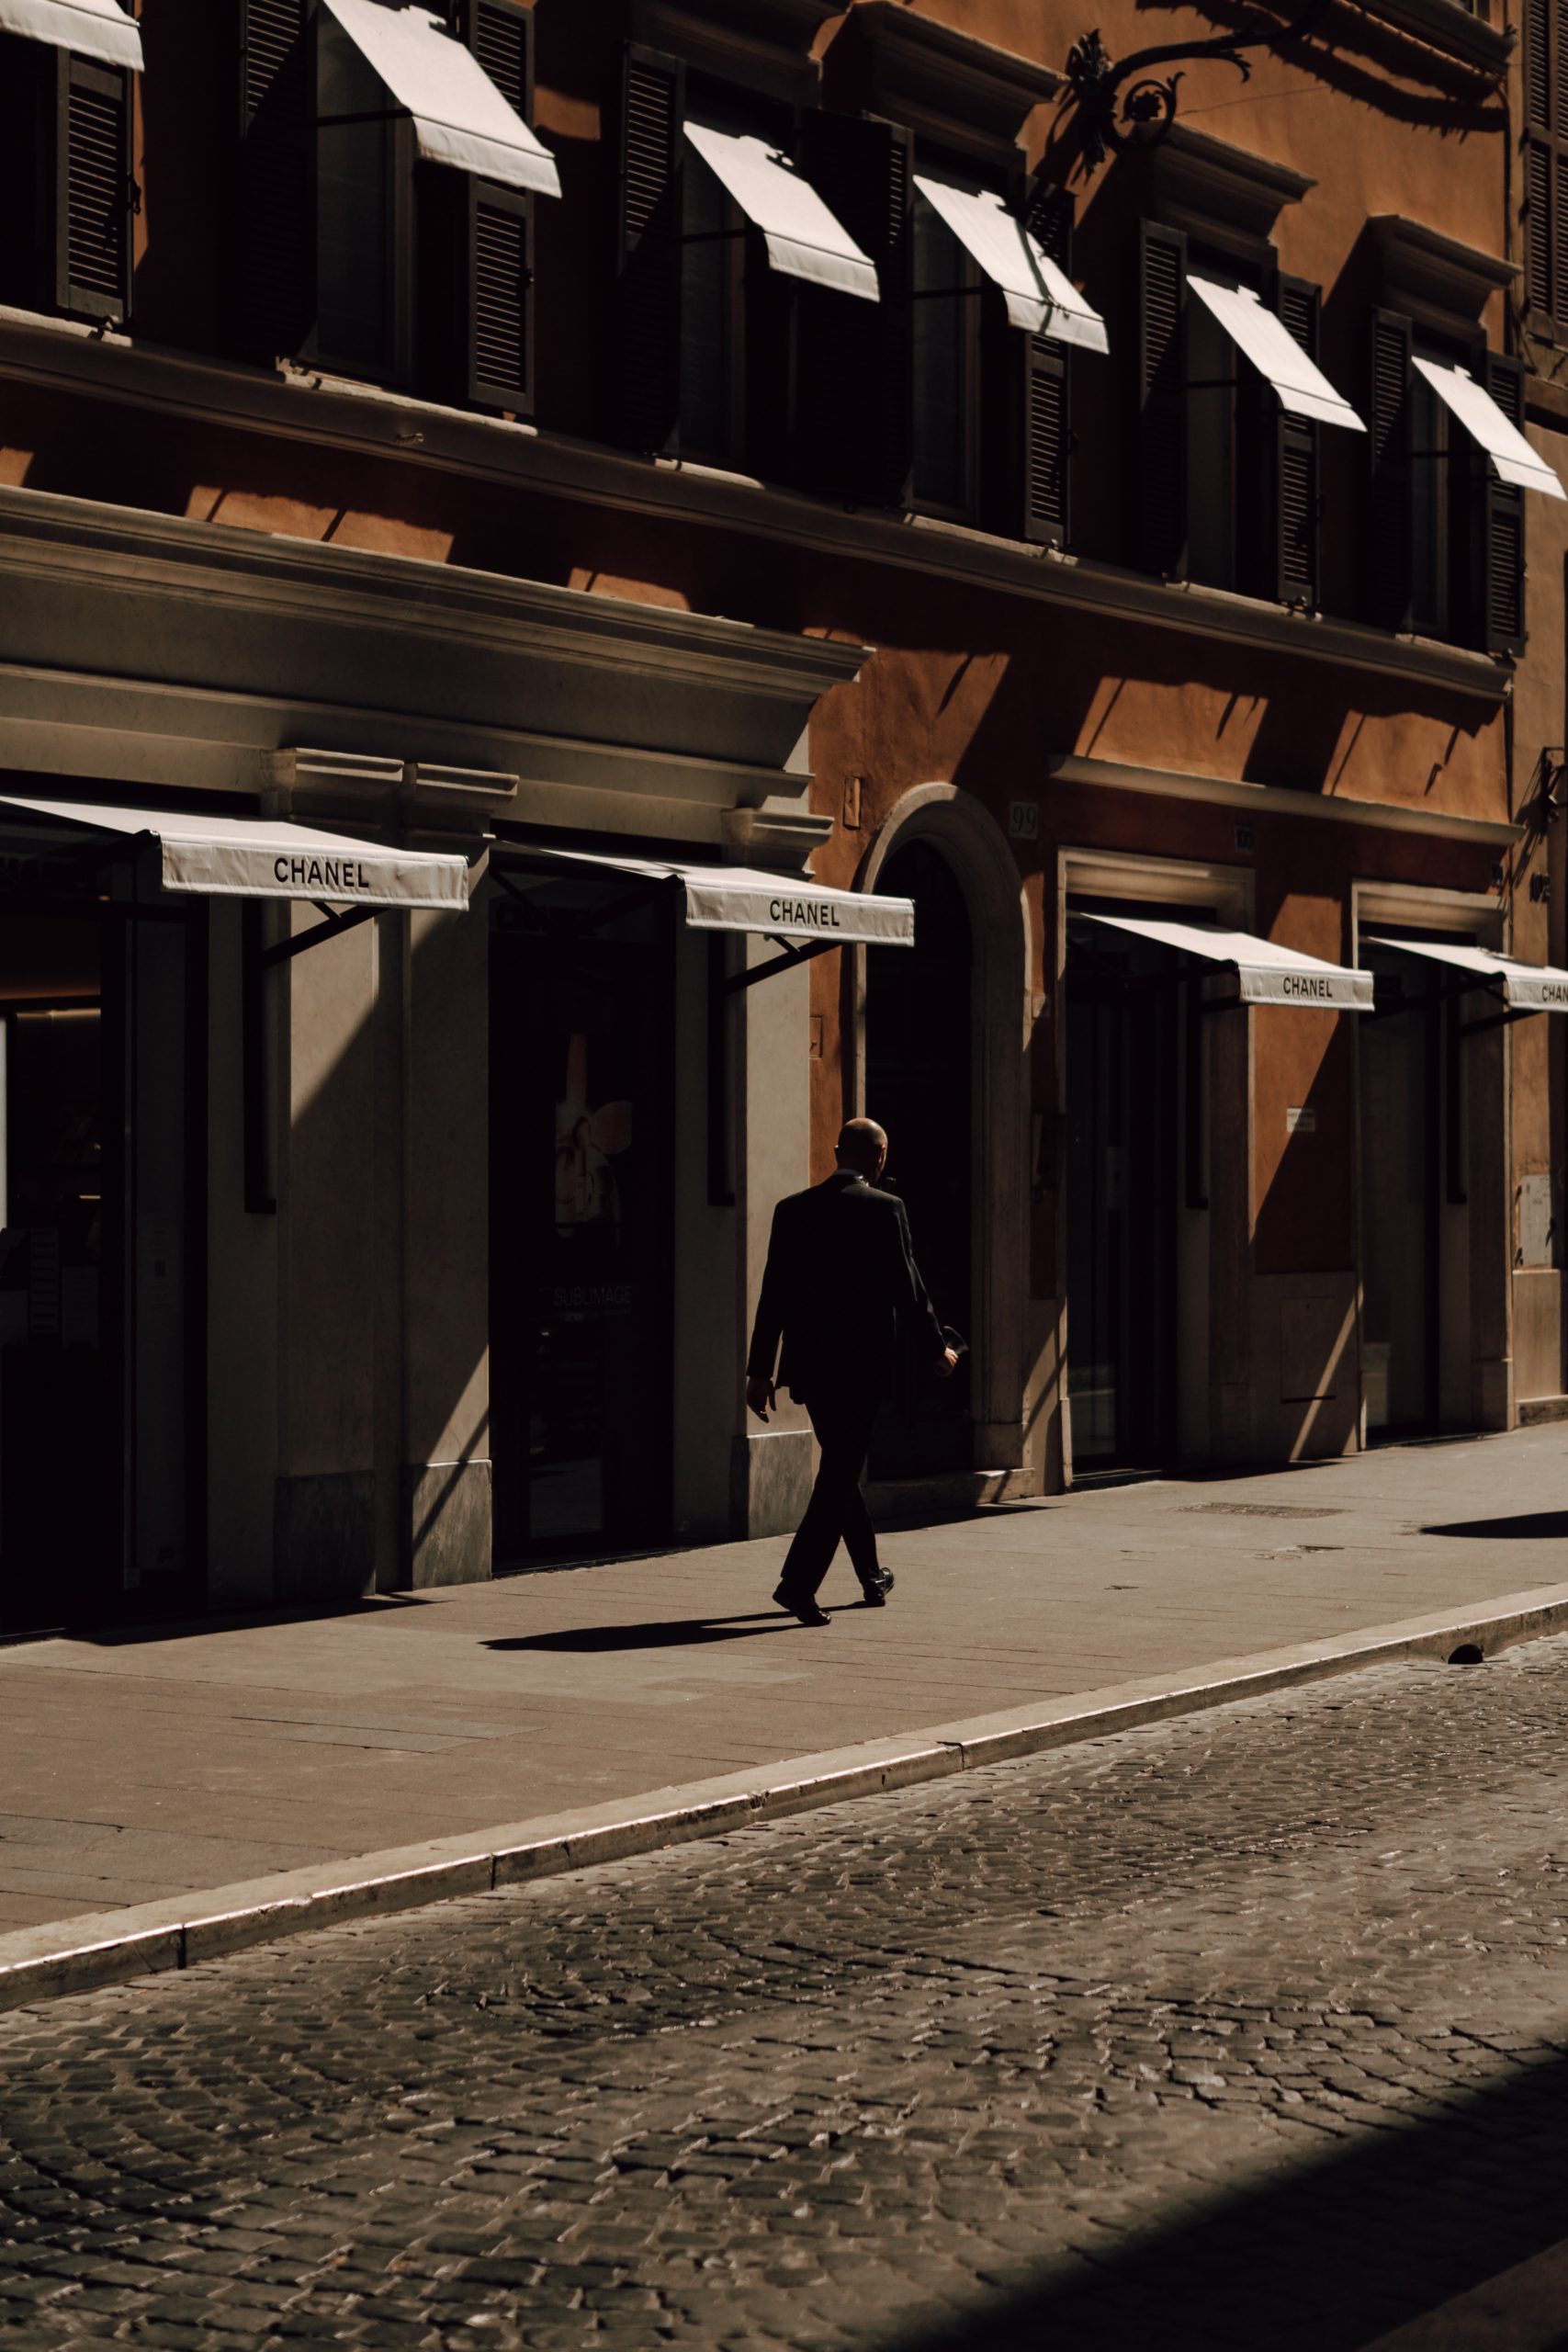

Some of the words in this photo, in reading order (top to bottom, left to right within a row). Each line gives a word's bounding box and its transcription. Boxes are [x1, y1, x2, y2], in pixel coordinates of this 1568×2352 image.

[1011, 805, 1037, 834] 99
[274, 857, 369, 888] CHANEL
[770, 899, 840, 927] CHANEL
[1282, 976, 1333, 998] CHANEL
[553, 1284, 633, 1306] SUBLIMAGE
